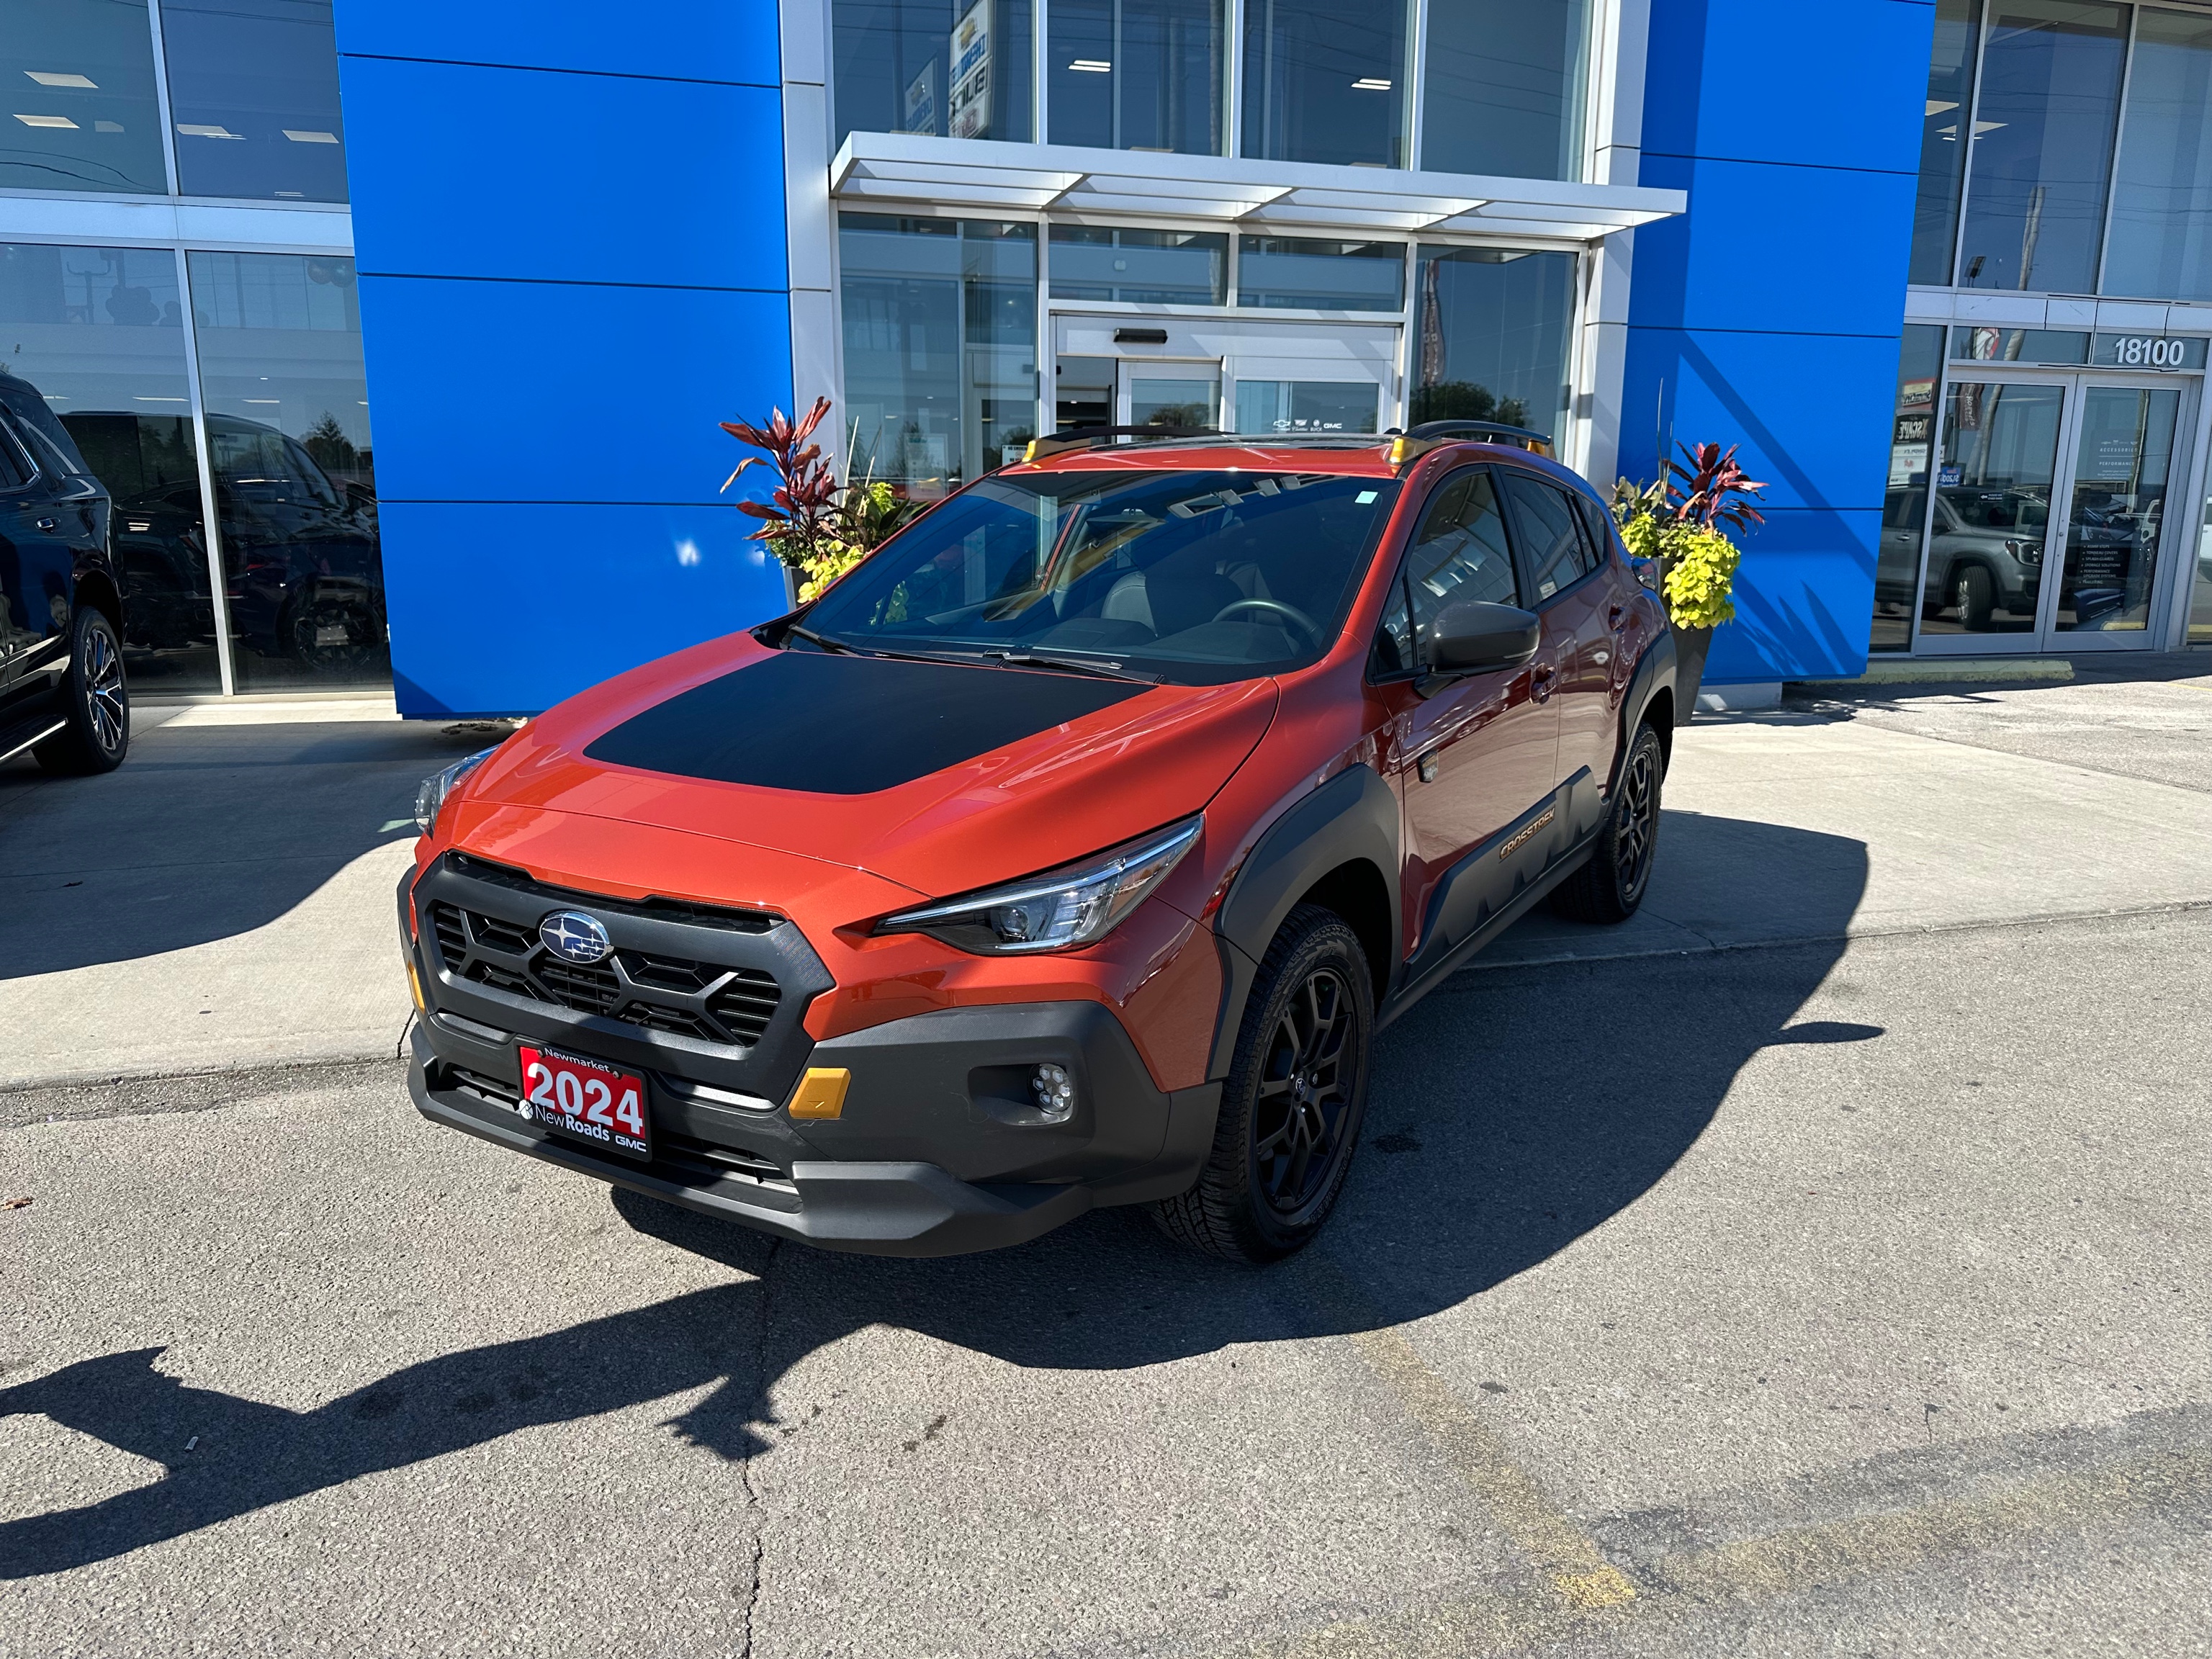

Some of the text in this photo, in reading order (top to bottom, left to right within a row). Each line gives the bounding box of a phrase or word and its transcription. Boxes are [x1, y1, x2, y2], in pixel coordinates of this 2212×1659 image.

[2116, 338, 2184, 366] 18100
[1499, 807, 1555, 860] CROSSTREK
[544, 1047, 611, 1073] Newmarket
[527, 1062, 643, 1135] 2024
[535, 1103, 610, 1141] NewRoads
[615, 1135, 647, 1153] GMC
